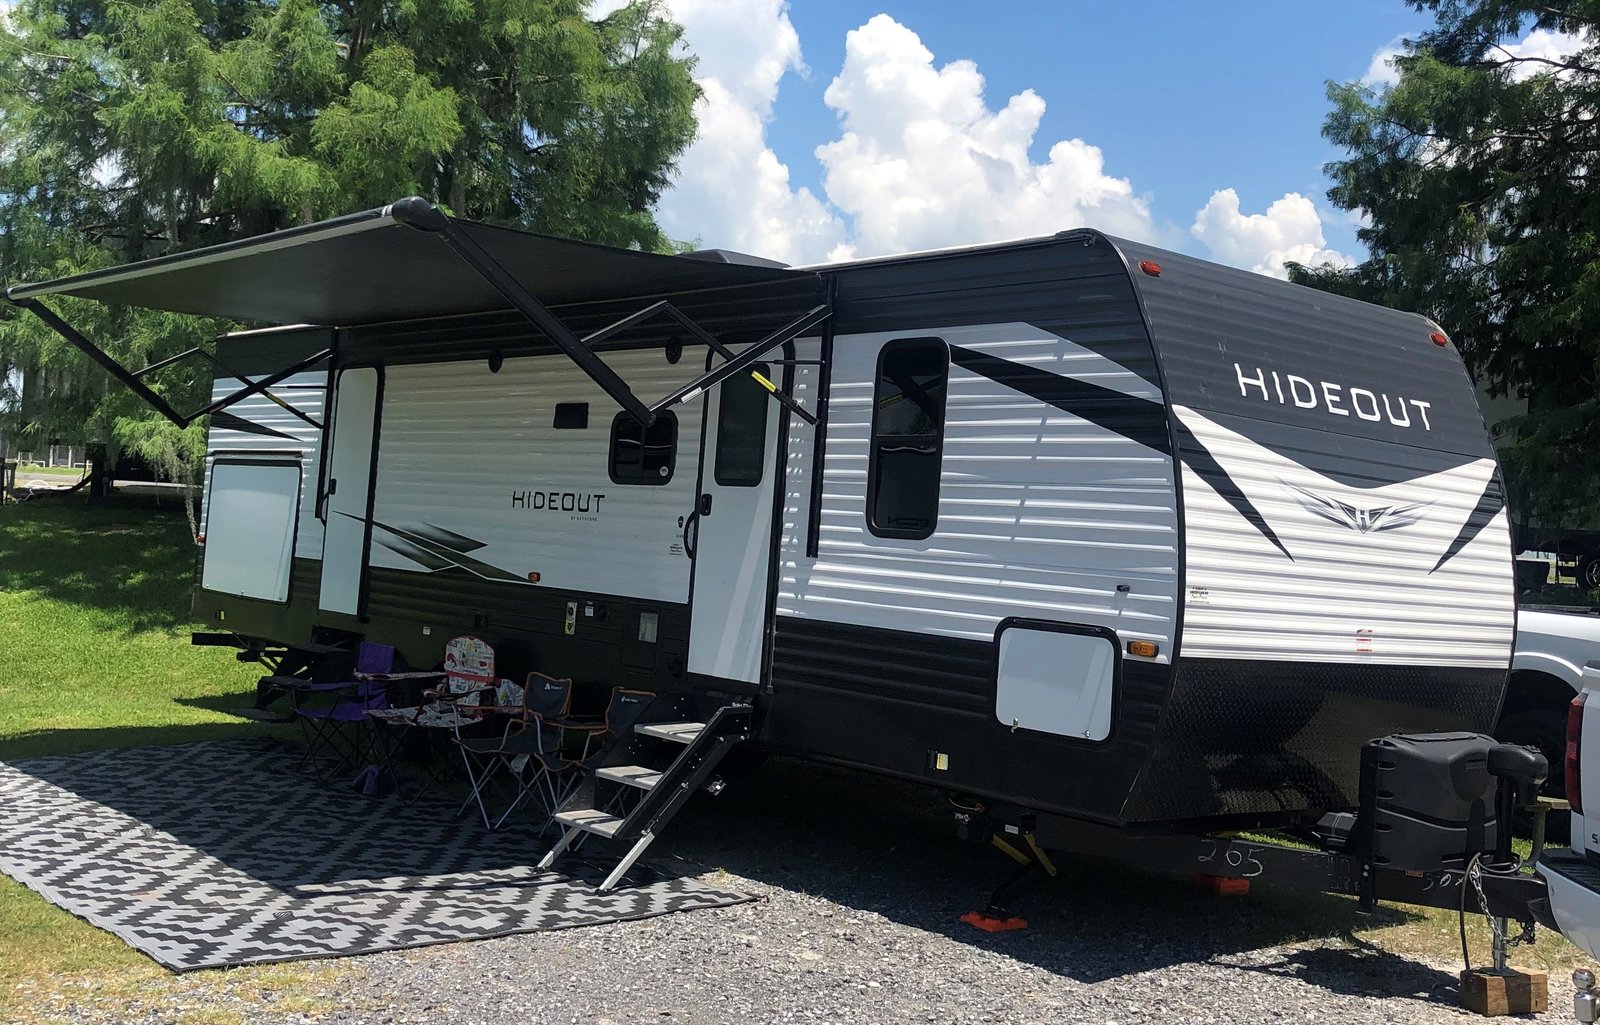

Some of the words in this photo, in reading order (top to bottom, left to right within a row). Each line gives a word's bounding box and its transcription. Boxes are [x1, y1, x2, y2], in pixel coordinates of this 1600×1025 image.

[1233, 362, 1431, 431] HIDEOUT
[512, 490, 606, 513] HIDEOUT
[1197, 839, 1265, 877] 265
